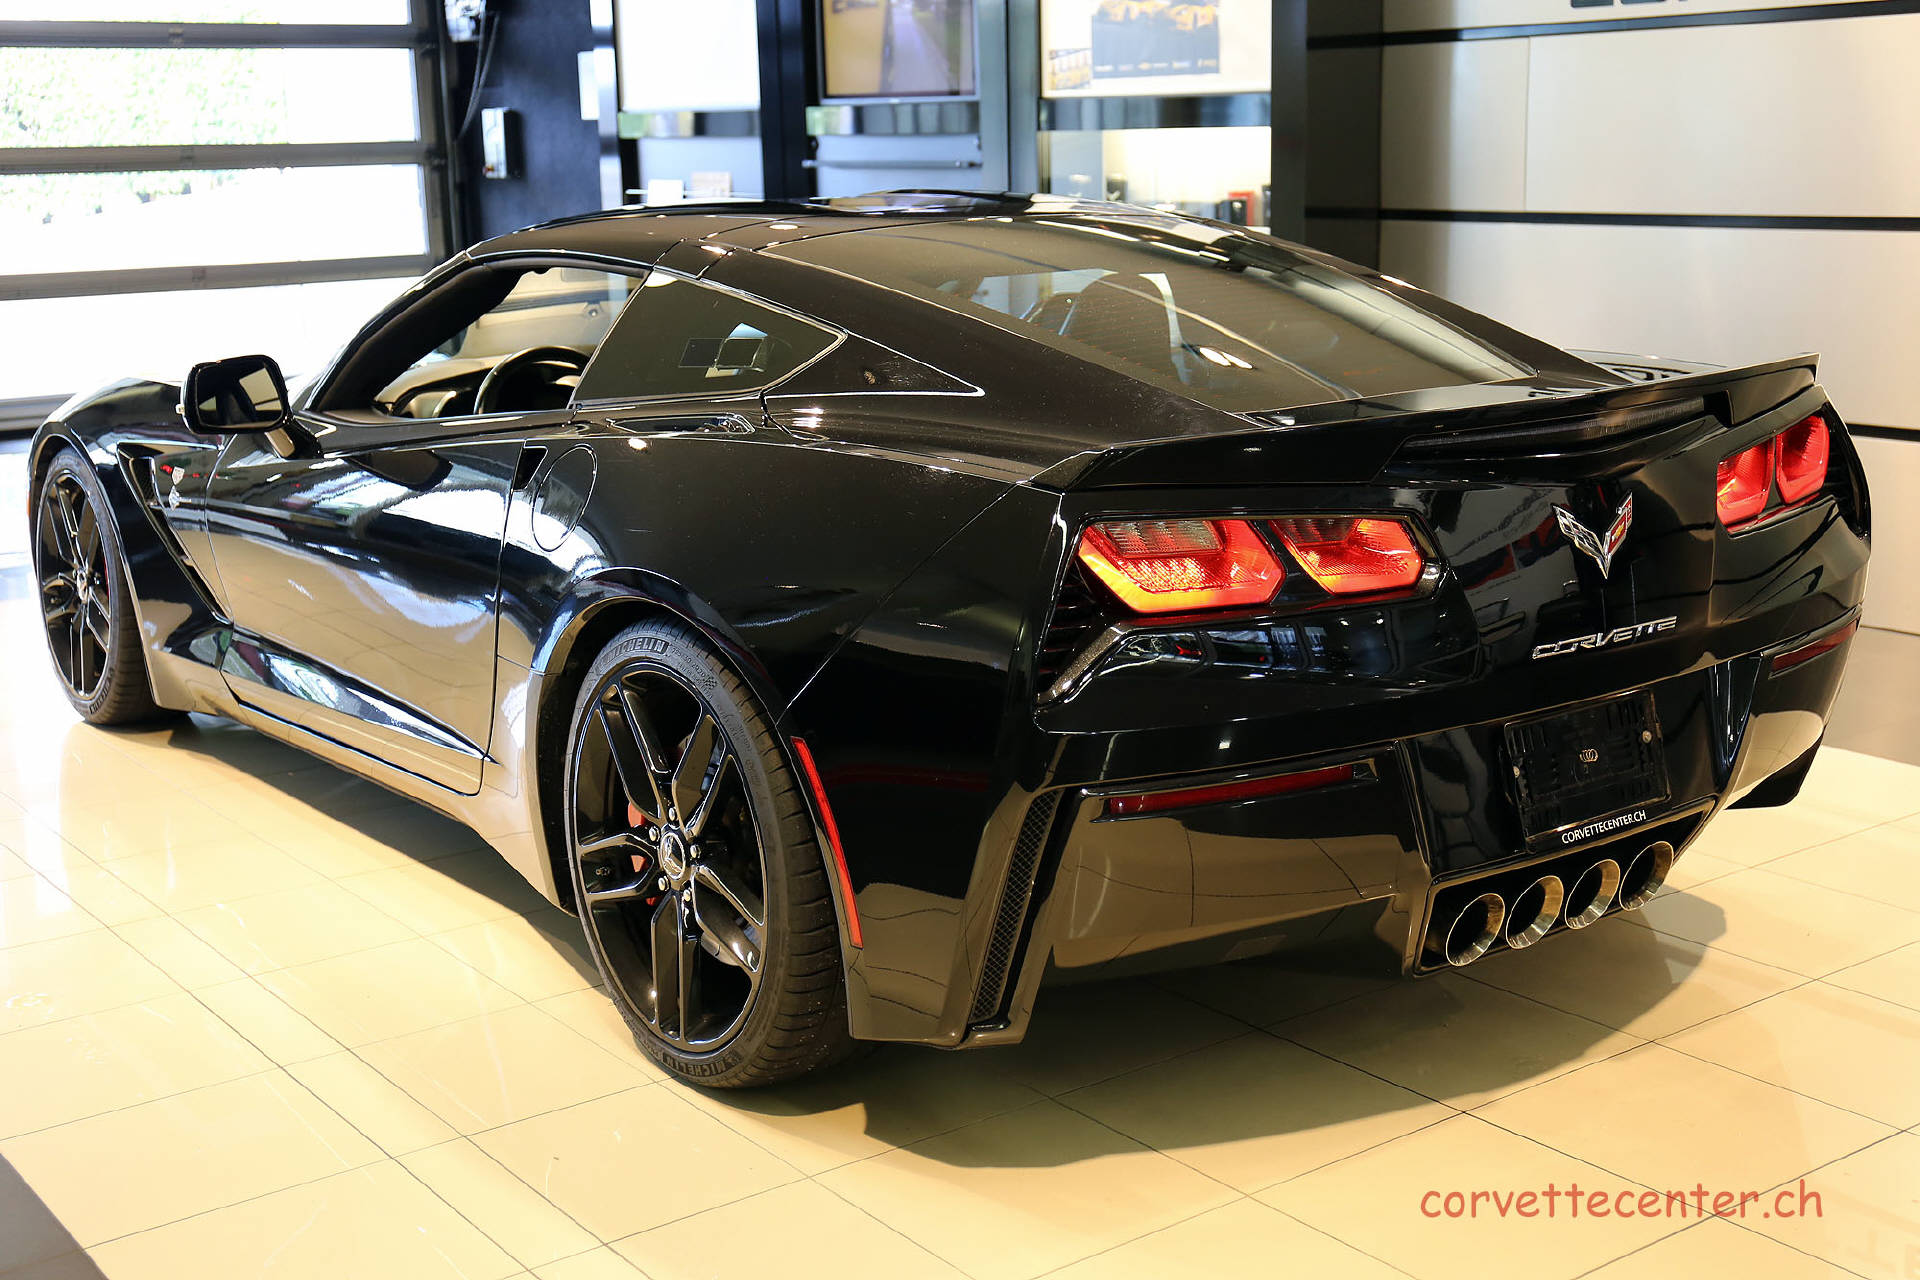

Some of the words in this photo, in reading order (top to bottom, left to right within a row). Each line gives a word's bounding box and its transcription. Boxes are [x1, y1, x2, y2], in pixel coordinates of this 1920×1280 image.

[606, 638, 666, 660] MICHELIN
[1532, 616, 1677, 659] CORVETTE
[1561, 809, 1647, 844] CORVETTECENTER.CH
[666, 1056, 727, 1077] MICHELIN
